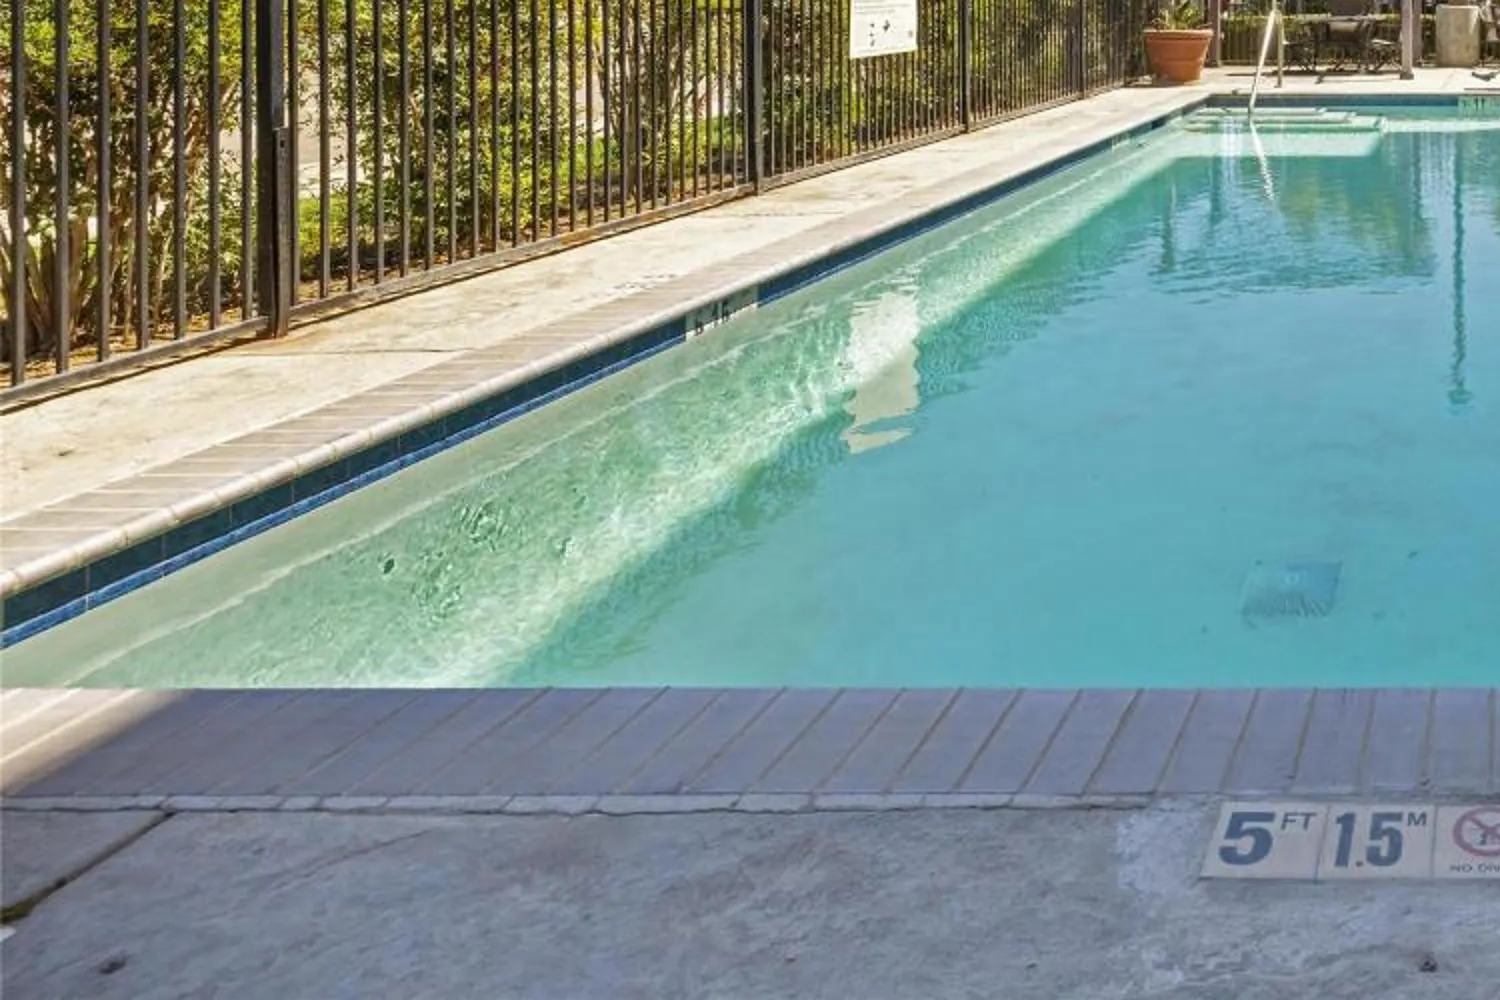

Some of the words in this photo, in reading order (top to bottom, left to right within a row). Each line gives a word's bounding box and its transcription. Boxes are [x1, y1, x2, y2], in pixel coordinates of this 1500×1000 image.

[1218, 811, 1275, 866] 5
[1281, 811, 1317, 831] FT
[1334, 812, 1404, 868] 1.5
[1407, 812, 1427, 827] M
[1449, 864, 1473, 873] NO
